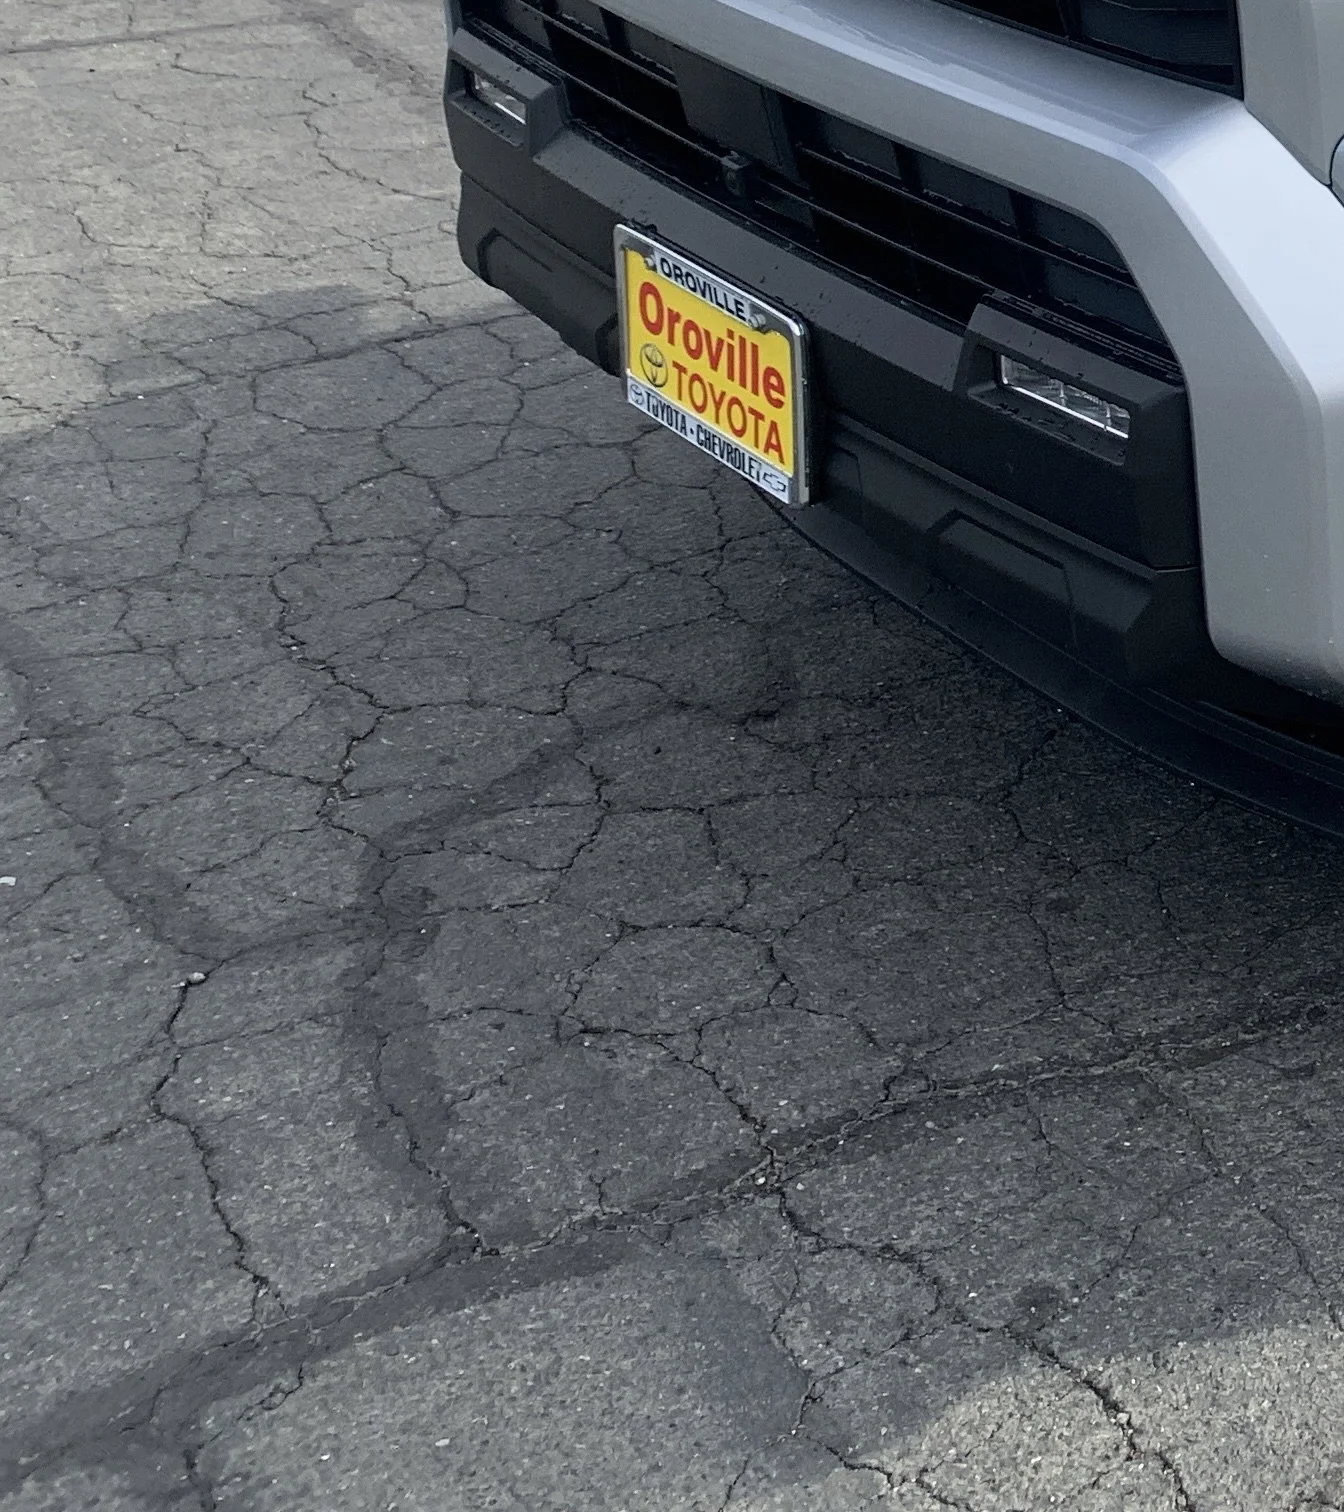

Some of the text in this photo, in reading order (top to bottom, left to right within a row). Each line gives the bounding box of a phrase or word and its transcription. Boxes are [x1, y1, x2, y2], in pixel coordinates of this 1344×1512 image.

[660, 257, 746, 322] OROVILLE
[639, 282, 785, 409] Oroville
[645, 391, 762, 483] TOYOTA CHEVROLET
[672, 361, 785, 465] TOYOTA
